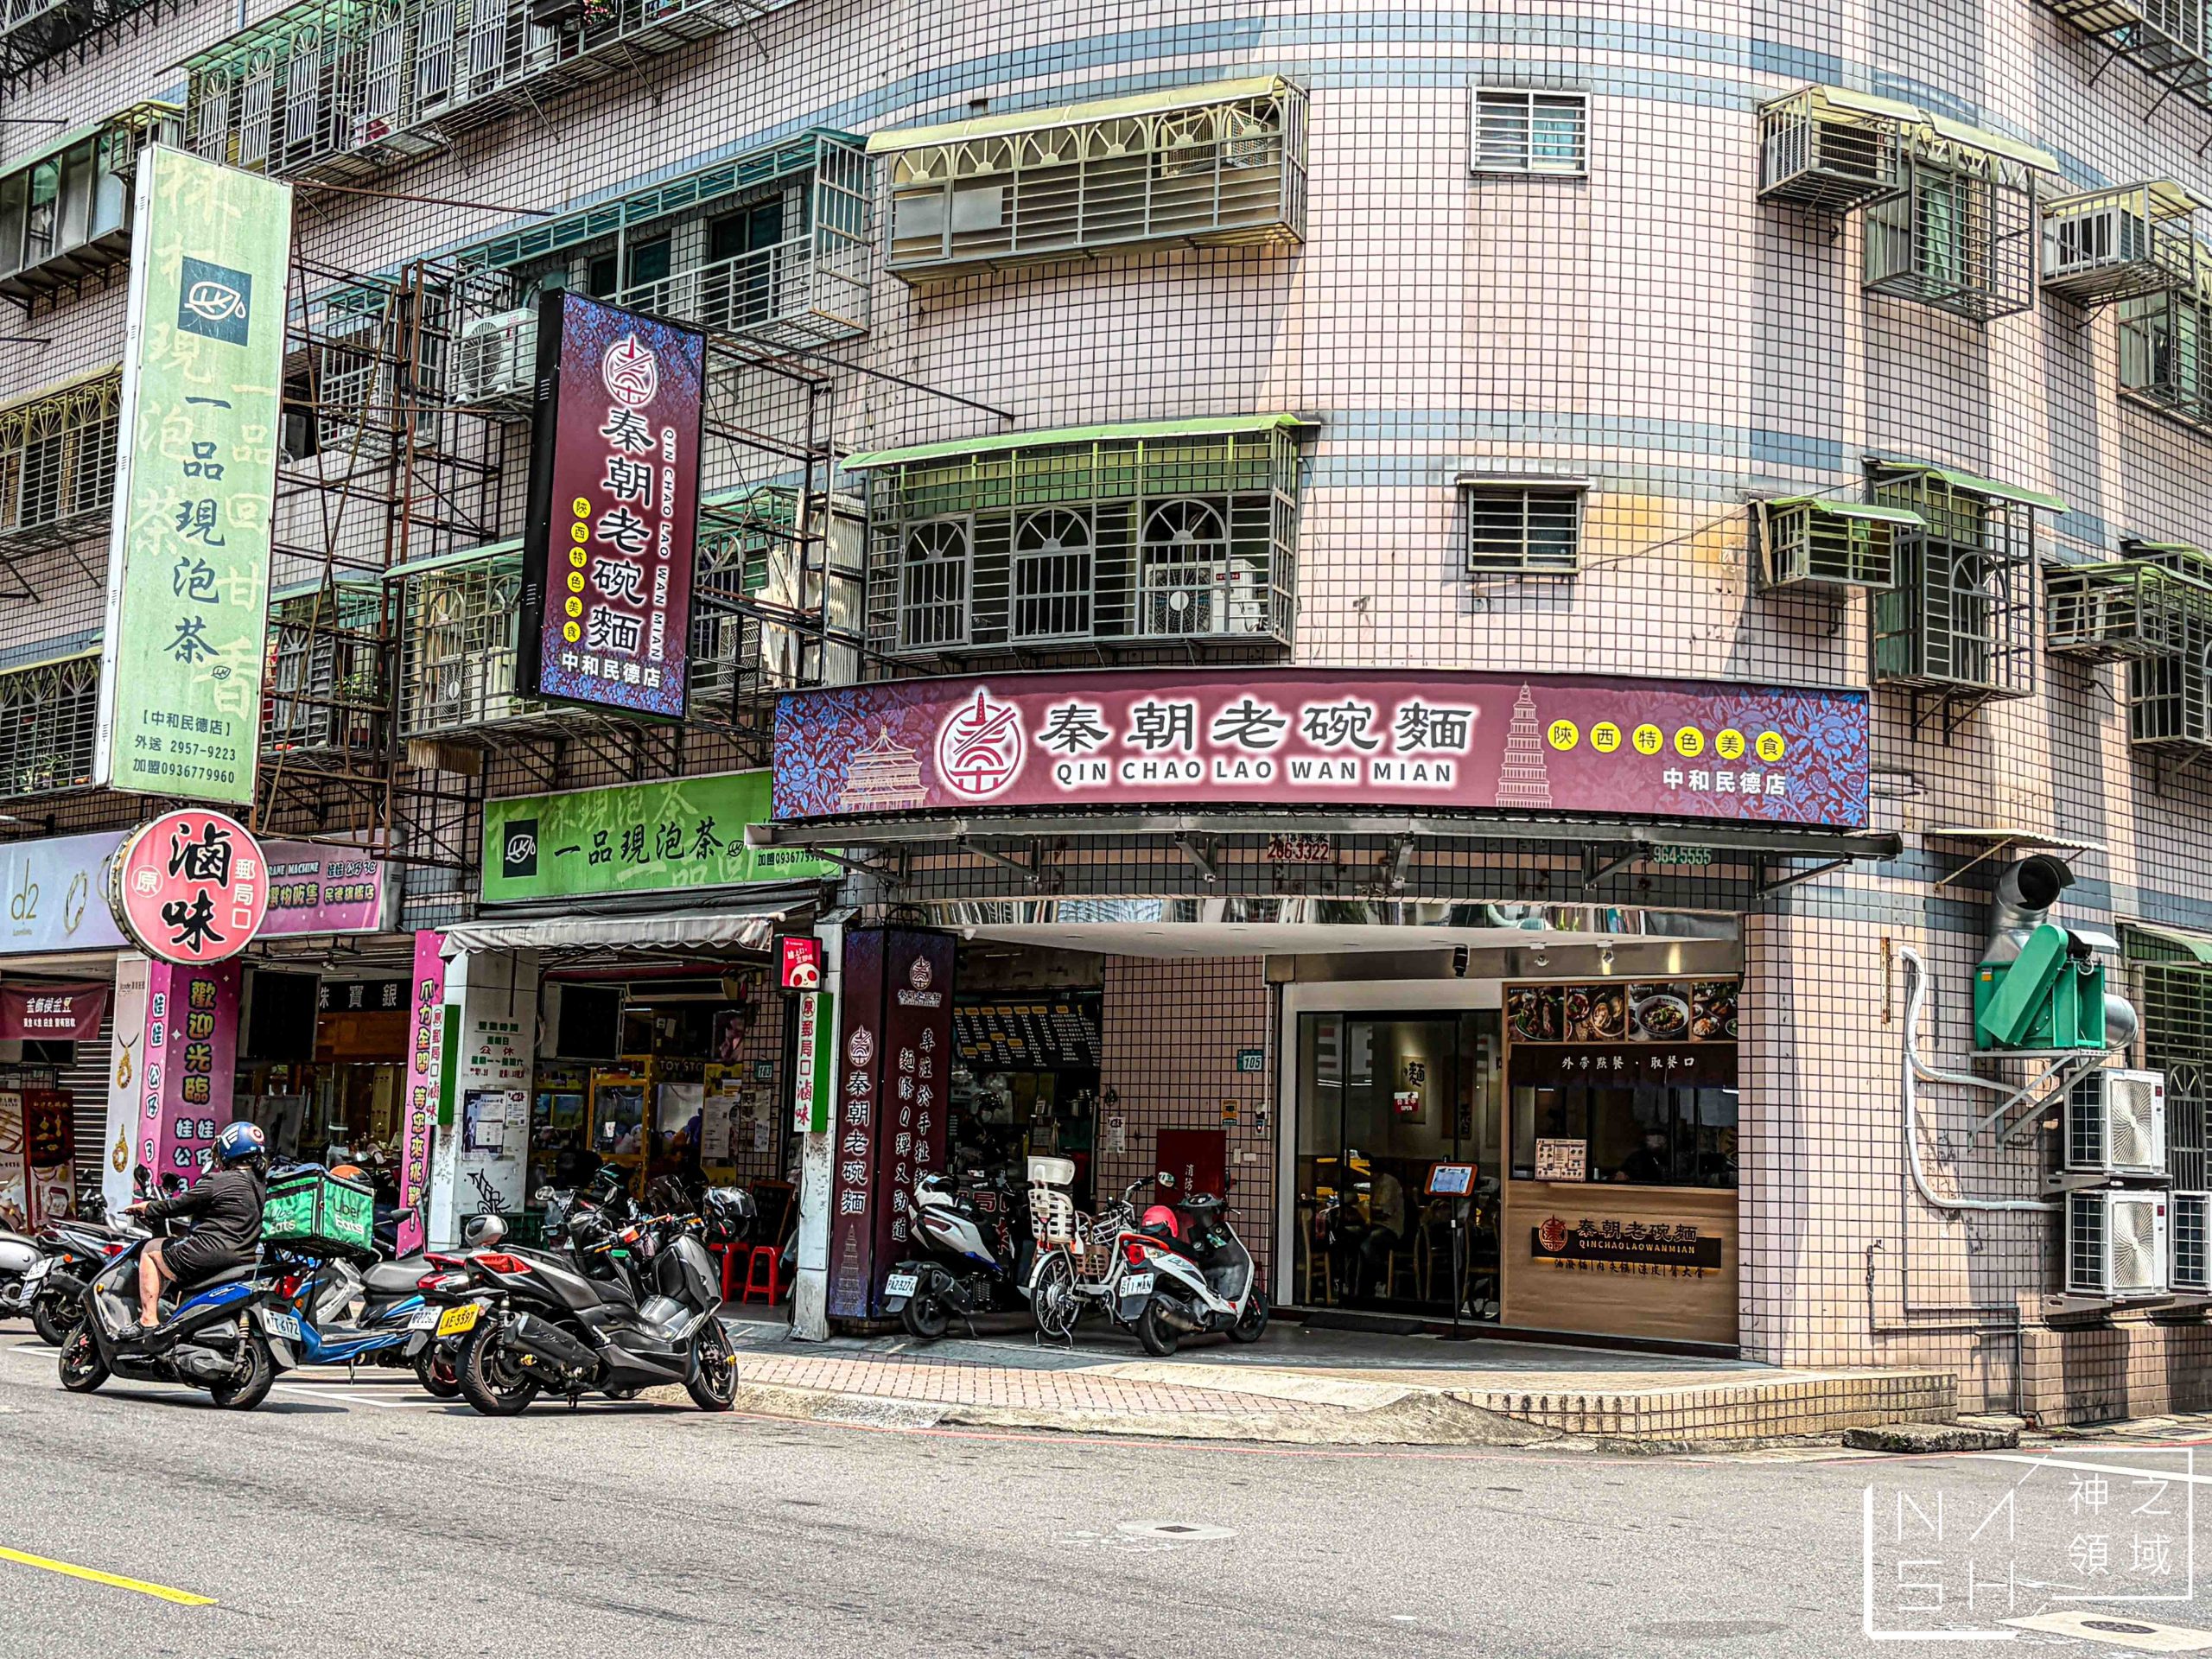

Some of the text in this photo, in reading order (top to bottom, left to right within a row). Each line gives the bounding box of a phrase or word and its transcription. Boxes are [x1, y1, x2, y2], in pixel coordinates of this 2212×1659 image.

[163, 394, 232, 664] 一品現泡茶
[588, 408, 656, 654] 秦朝老碗麵
[650, 429, 677, 659] QIN CHAO LAO WAN MIAN
[567, 500, 588, 639] 陝西特色美食
[561, 651, 661, 688] 中和民德店
[1039, 699, 1473, 751] 秦朝老碗麵
[1552, 724, 1780, 757] 陝西特色美食
[135, 734, 236, 761] 外送 2957-9223
[132, 757, 236, 784] 加盟0936779960
[1057, 760, 1451, 784] QIN CHAO LAO WAN MIAN
[1662, 766, 1787, 796] 中和民德店
[553, 816, 724, 867] 一品現泡茶
[137, 869, 157, 894] 原
[288, 861, 320, 876] MACHINE
[161, 822, 232, 954] 滷味
[231, 858, 257, 929] 郵局口
[182, 978, 218, 1105] 歡迎光臨
[1243, 1056, 1262, 1071] 105
[175, 1118, 216, 1139] 娃娃
[841, 1071, 872, 1216] 秦朝老碗麵
[1575, 1218, 1698, 1243] 秦朝老碗麵
